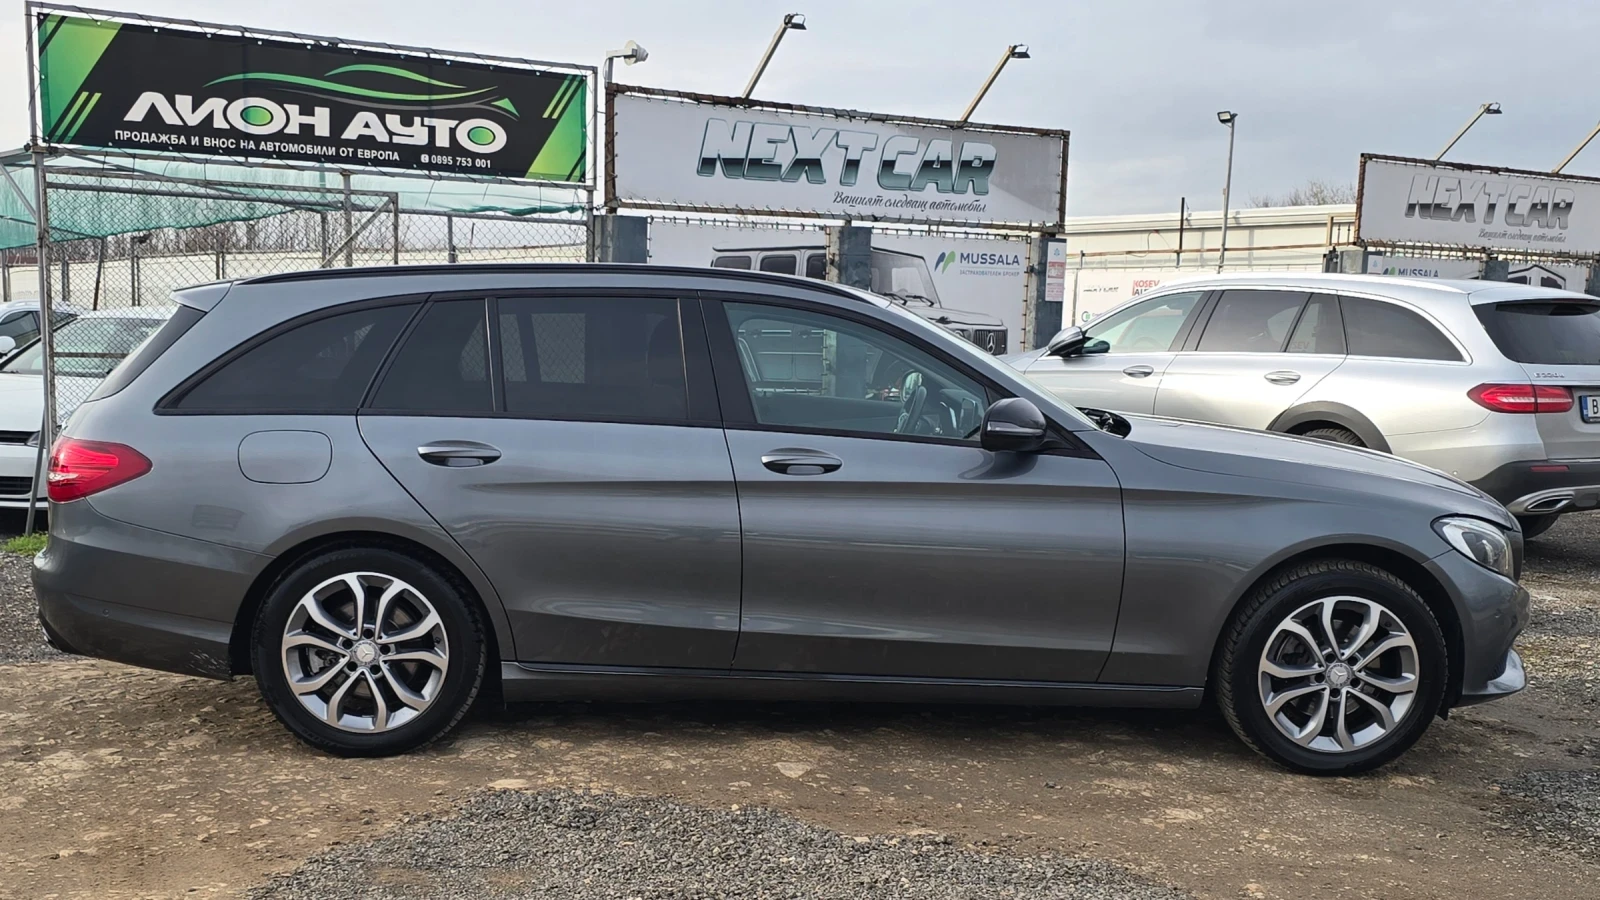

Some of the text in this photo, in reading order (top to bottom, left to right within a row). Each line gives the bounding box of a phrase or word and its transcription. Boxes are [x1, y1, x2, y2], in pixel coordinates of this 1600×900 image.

[123, 91, 507, 154] ЛИОН АУТО
[114, 129, 400, 161] ПРОДАЖБА И ВНОС НА АВТОМОБИЛИ ОТ ЕВРОПА
[696, 117, 997, 195] NEXT CAR
[431, 154, 491, 168] 0895 753 001
[832, 190, 988, 213] Вашият следващ автомобил
[960, 252, 1020, 266] MUSSALA
[1134, 280, 1160, 288] KOSEV
